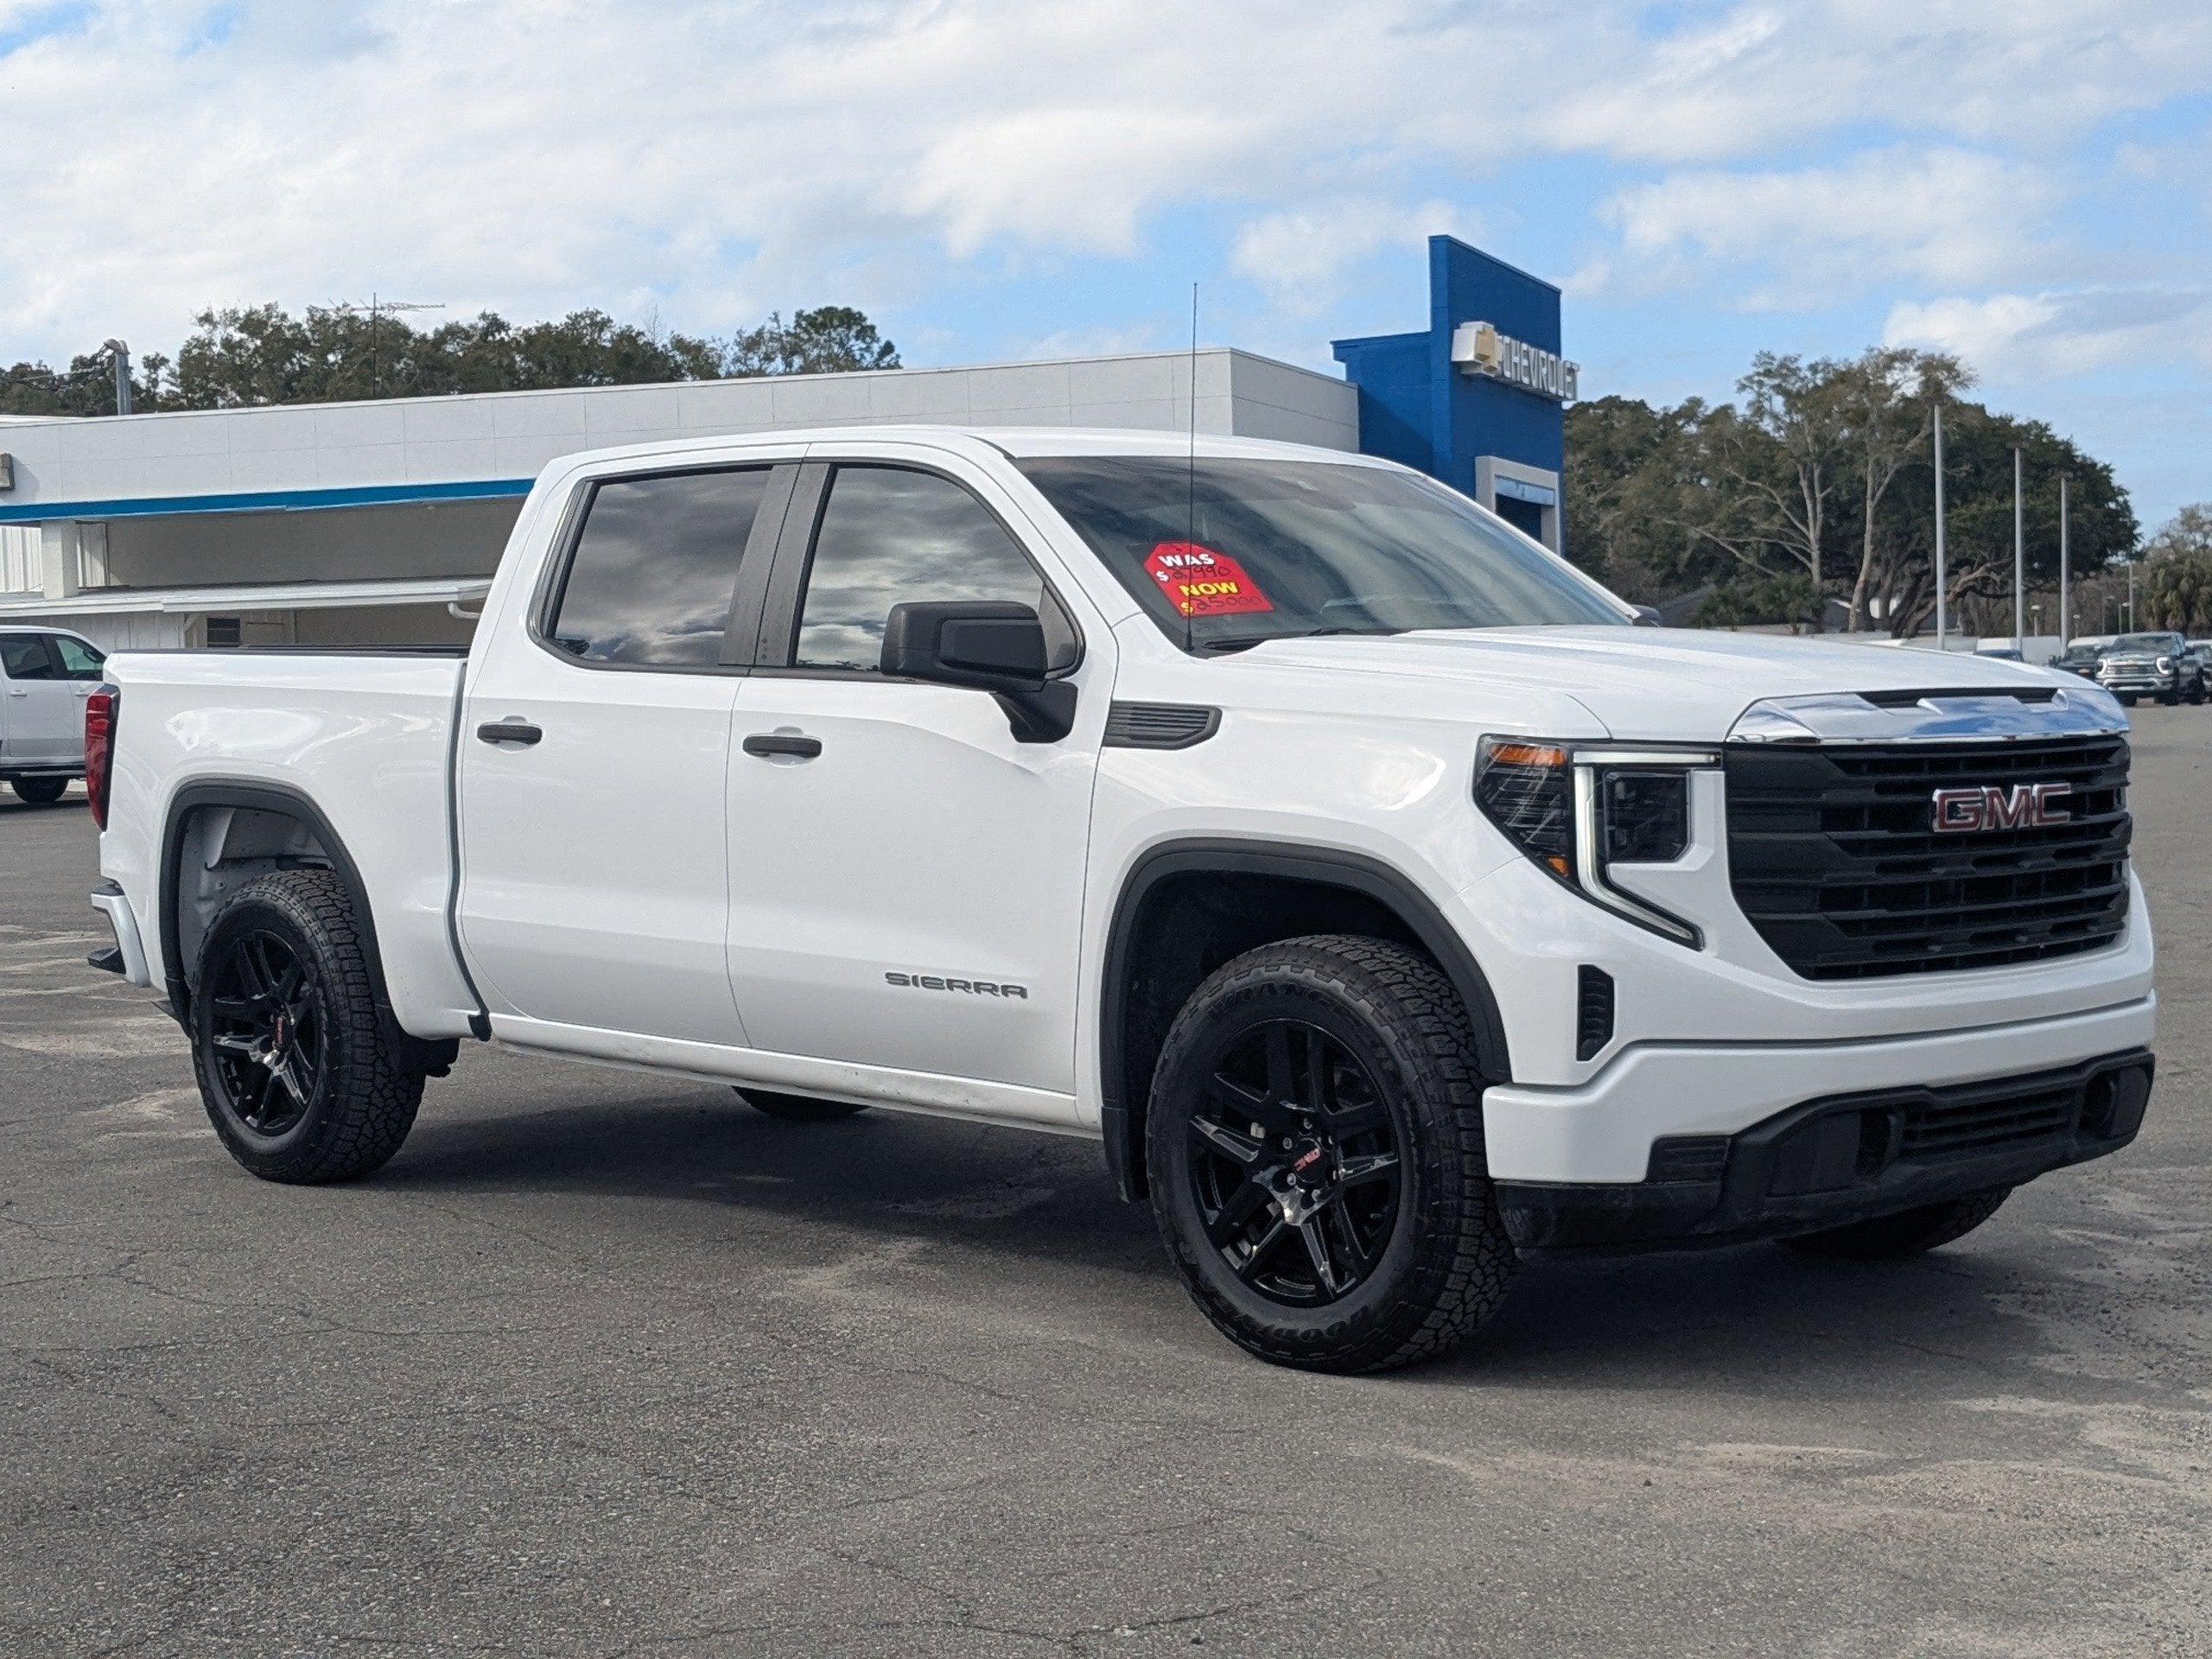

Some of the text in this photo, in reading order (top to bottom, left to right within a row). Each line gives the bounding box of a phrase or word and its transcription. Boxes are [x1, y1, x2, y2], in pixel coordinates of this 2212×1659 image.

[1503, 335, 1580, 401] CHEVROLET
[1157, 553, 1216, 568] WAS
[1179, 582, 1239, 597] NOW
[1932, 783, 2072, 833] GMC
[885, 971, 1029, 1000] SIERRA
